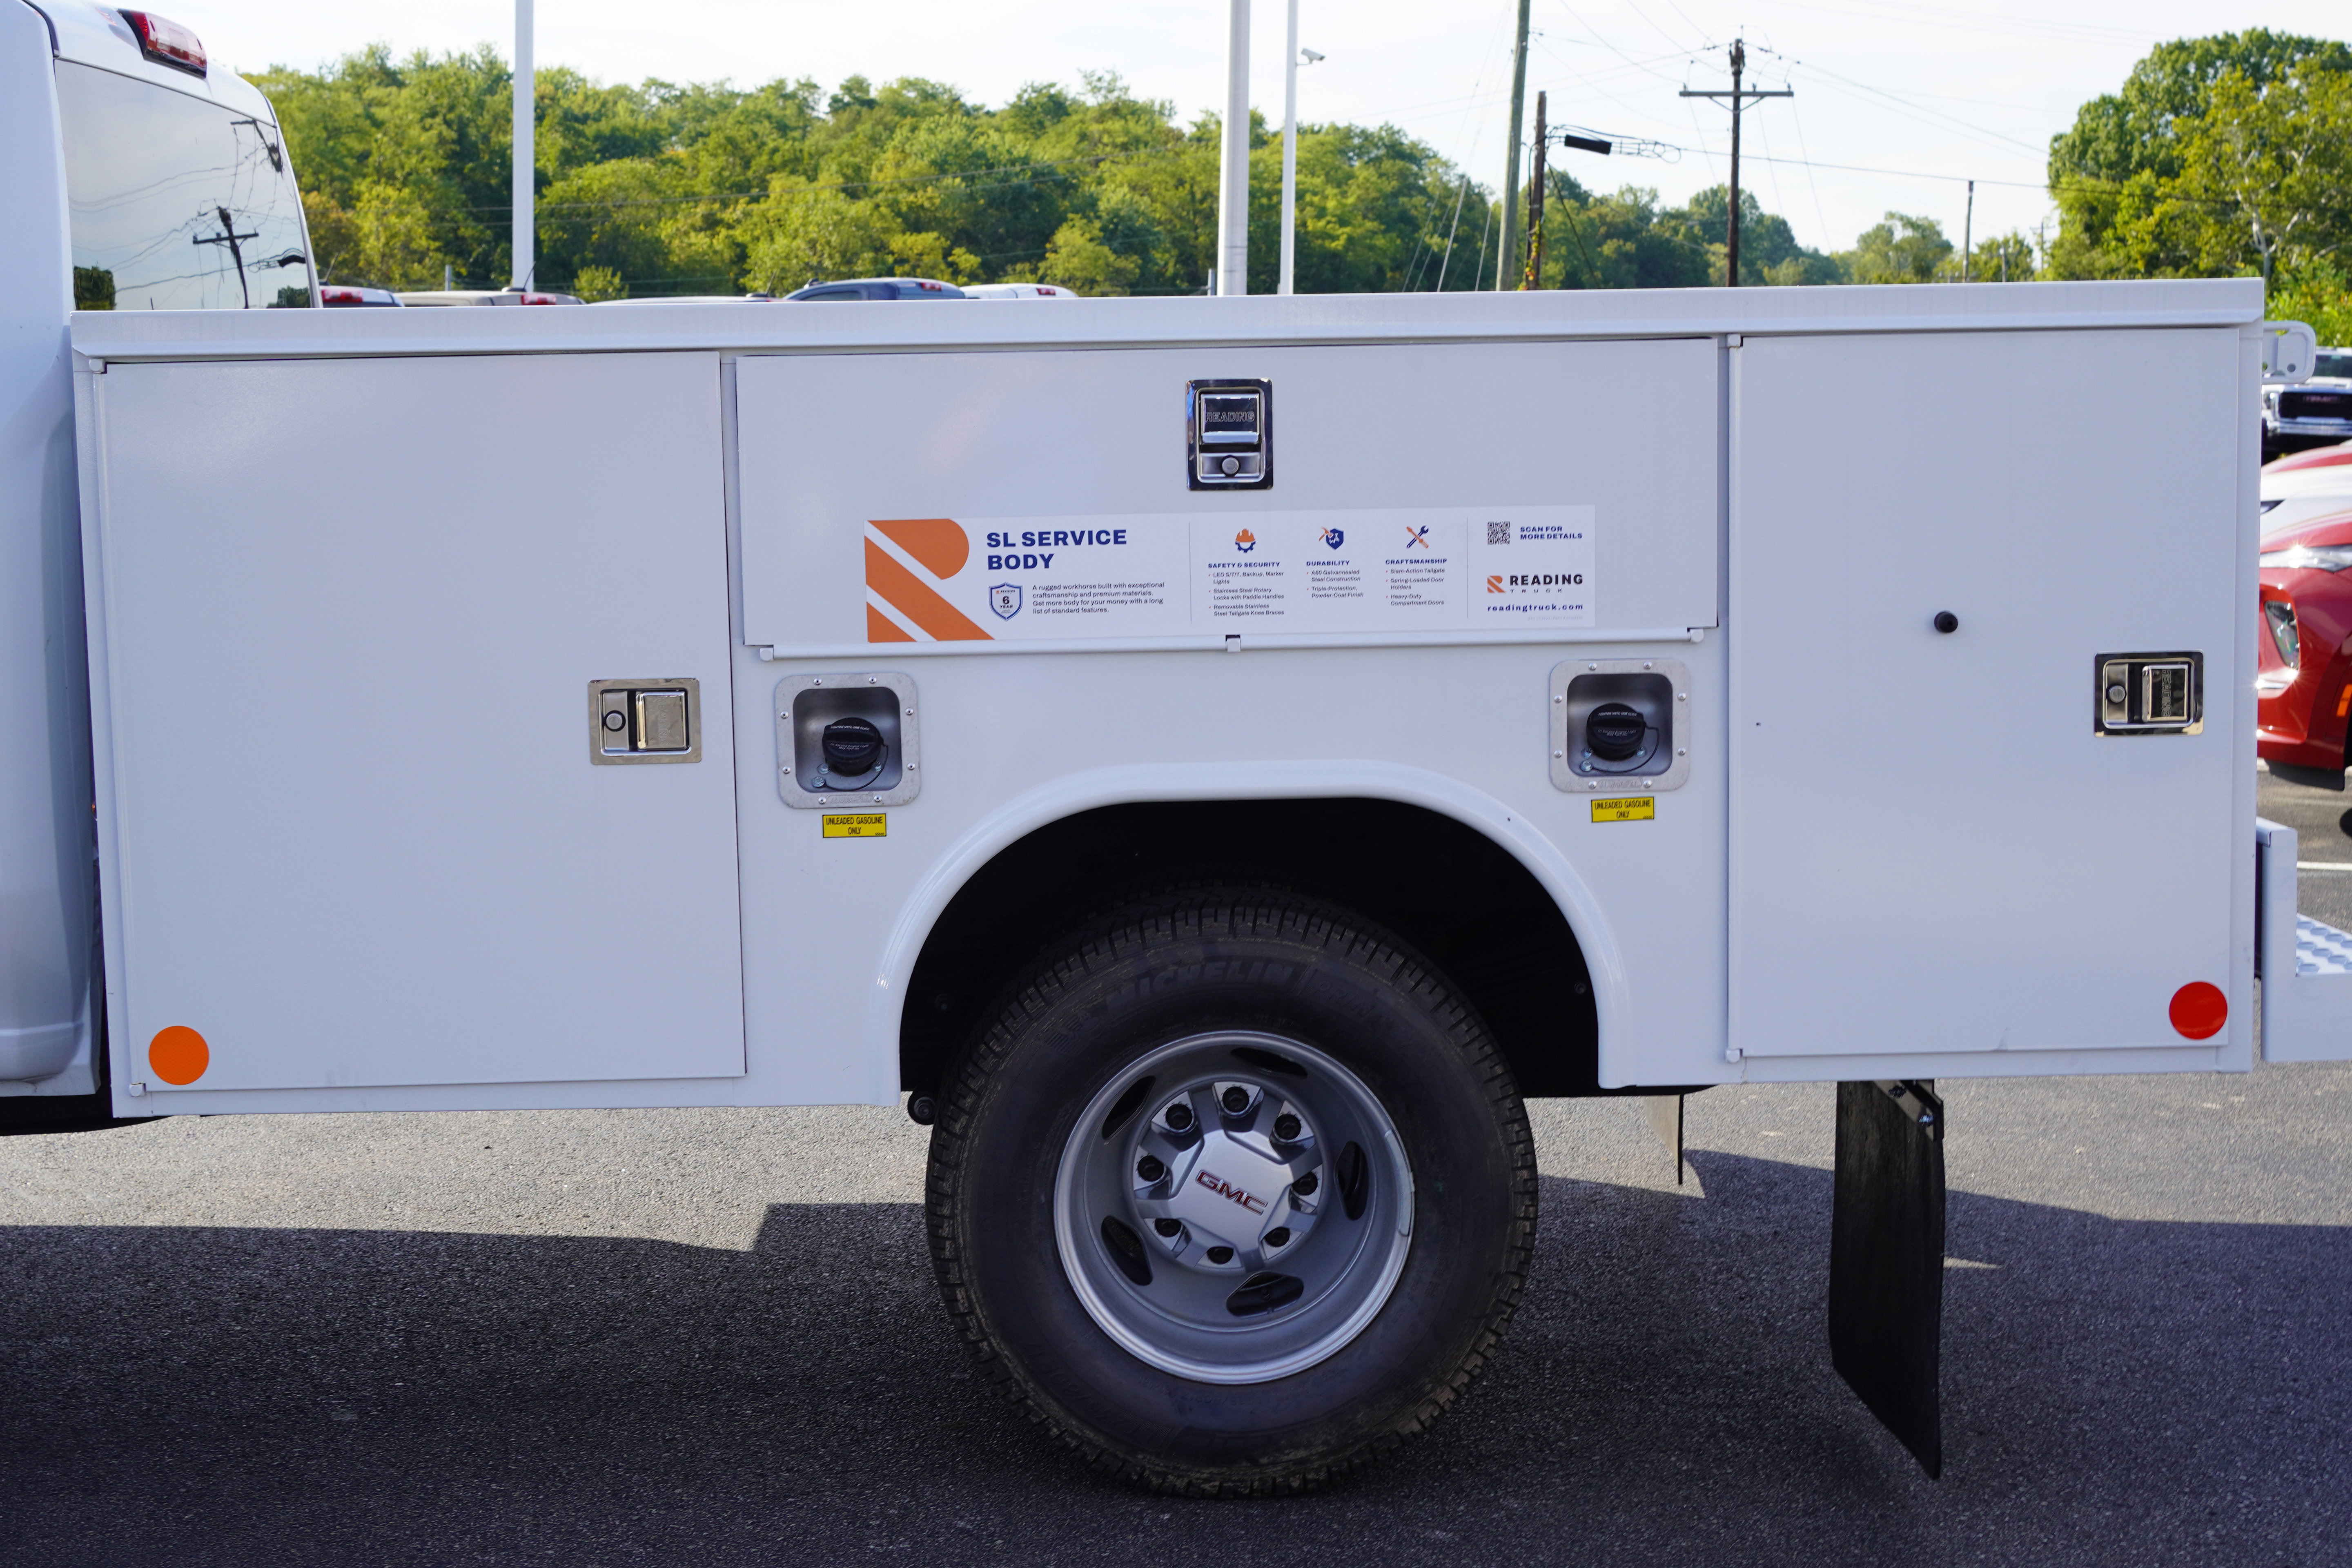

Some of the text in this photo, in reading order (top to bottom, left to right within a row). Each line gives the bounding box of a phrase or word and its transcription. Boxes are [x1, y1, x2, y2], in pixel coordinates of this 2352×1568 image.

[1206, 412, 1255, 422] READING
[987, 529, 1127, 548] SL SERVICE
[988, 553, 1055, 570] BODY
[1510, 574, 1582, 586] READING
[1002, 596, 1009, 604] 6
[1488, 604, 1583, 612] readingtruck.com
[1595, 800, 1651, 810] UNLEADED GASOLINE
[1616, 810, 1630, 819] ONLY
[826, 816, 883, 825] UNLEADED GASOLINE
[1098, 959, 1296, 1019] MICHELIN
[1195, 1169, 1268, 1216] GMC
